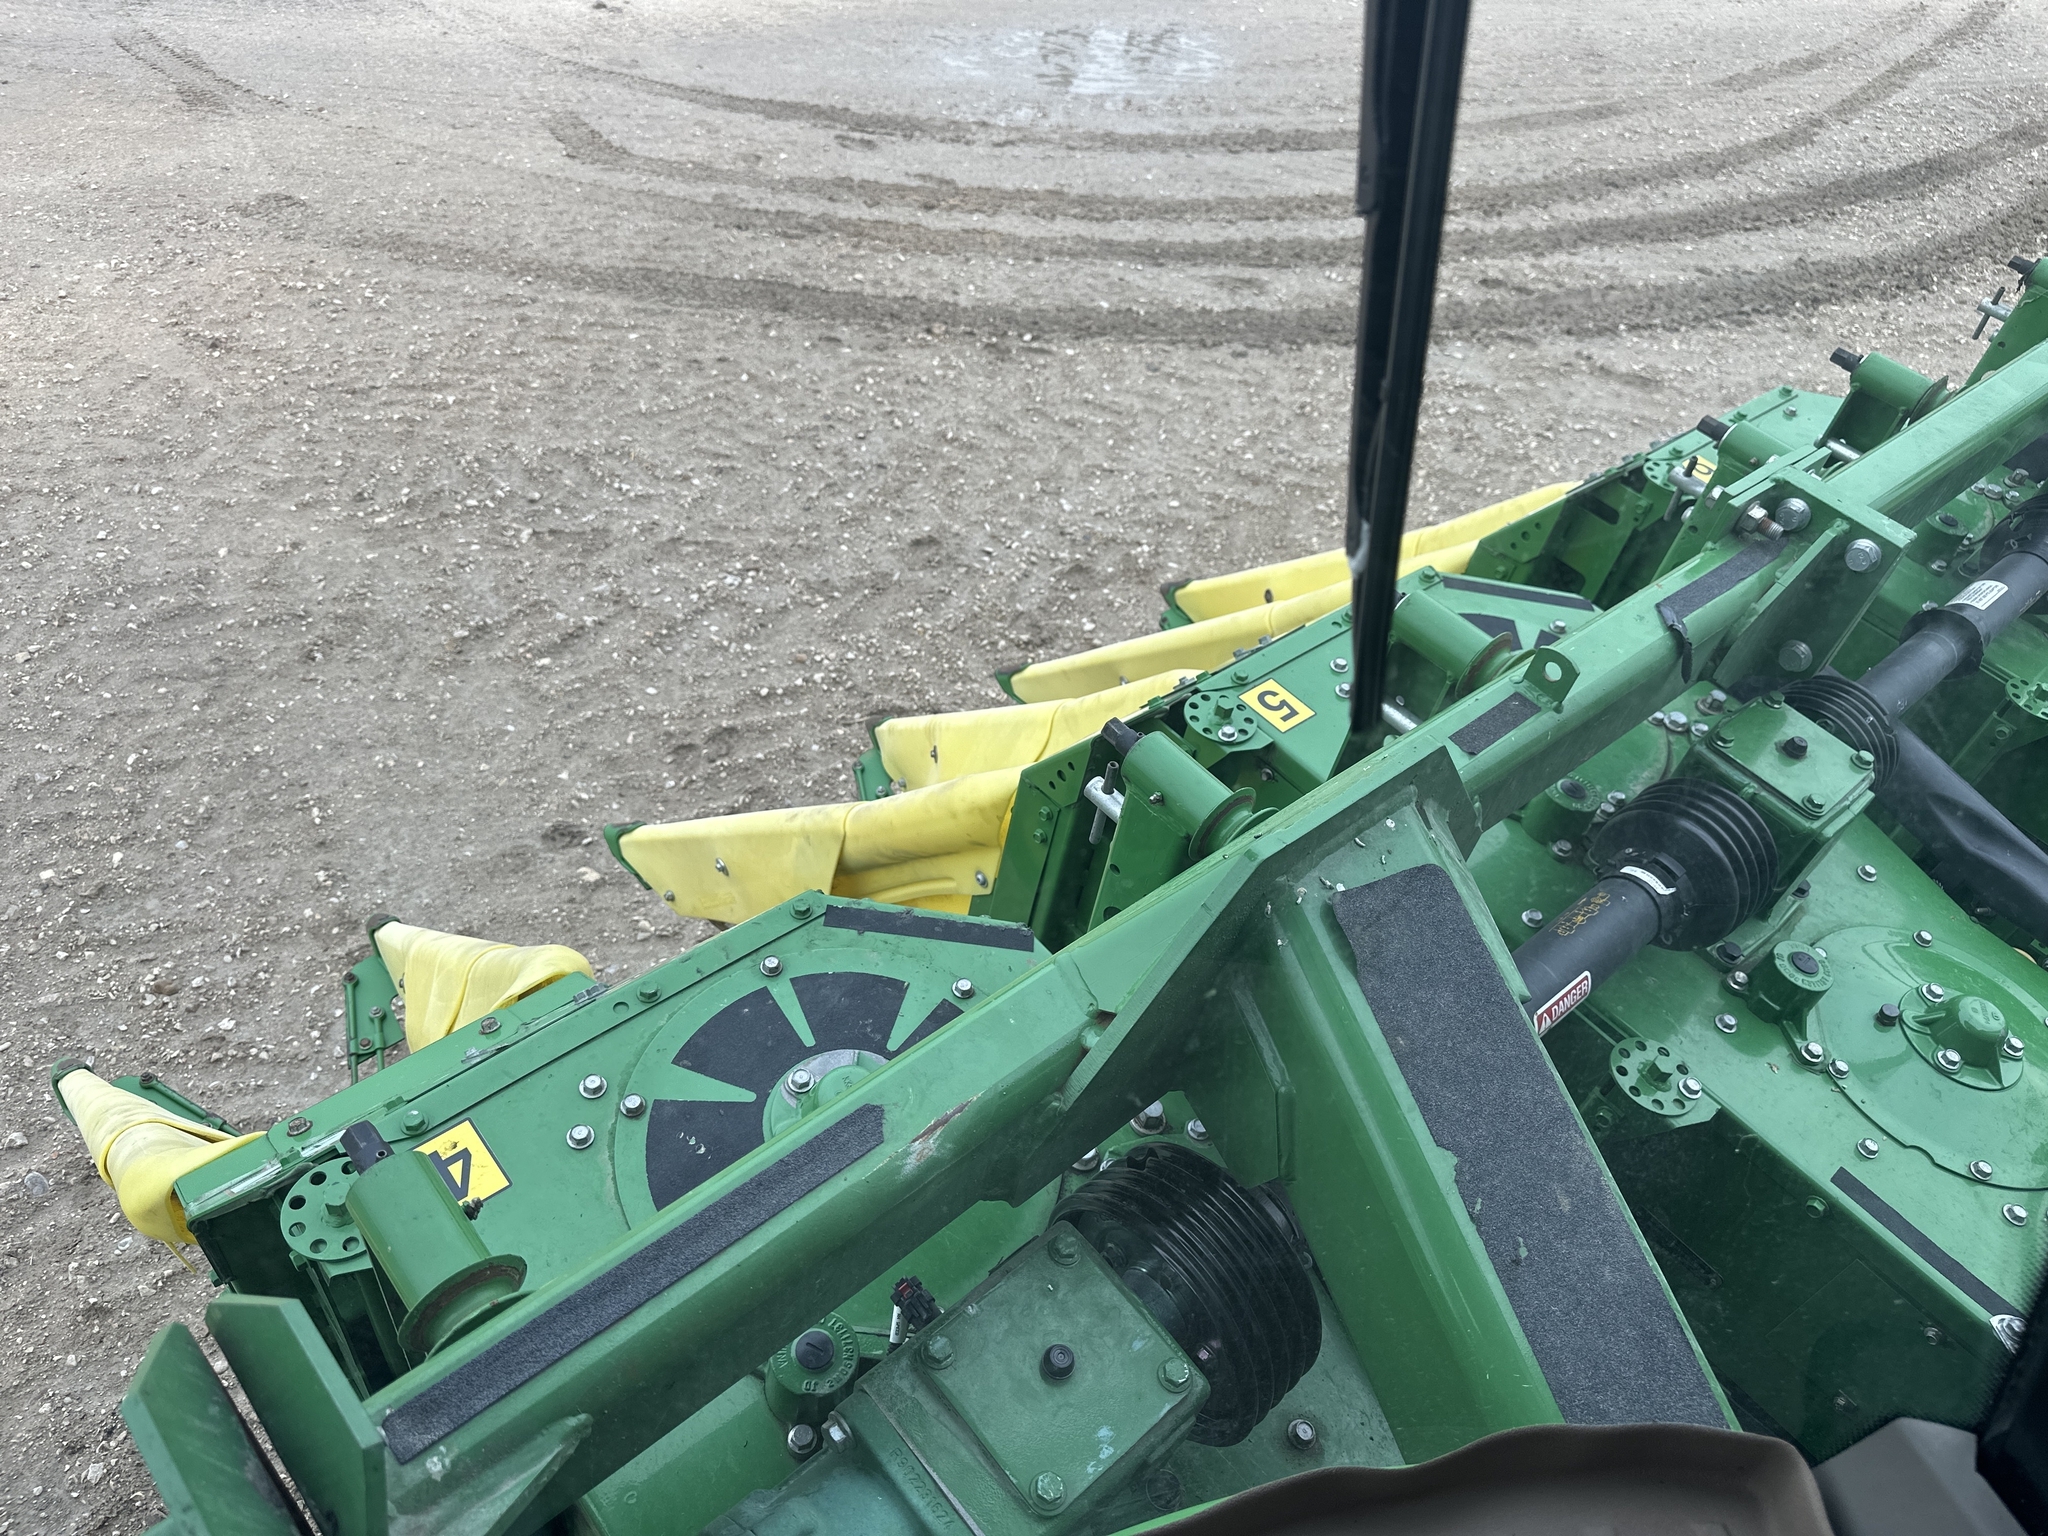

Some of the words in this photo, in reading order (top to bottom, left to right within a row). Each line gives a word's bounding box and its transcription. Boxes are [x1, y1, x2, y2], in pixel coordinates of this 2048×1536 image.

[1257, 690, 1299, 723] 5
[1551, 979, 1588, 1021] DANGER
[427, 1147, 472, 1202] 4
